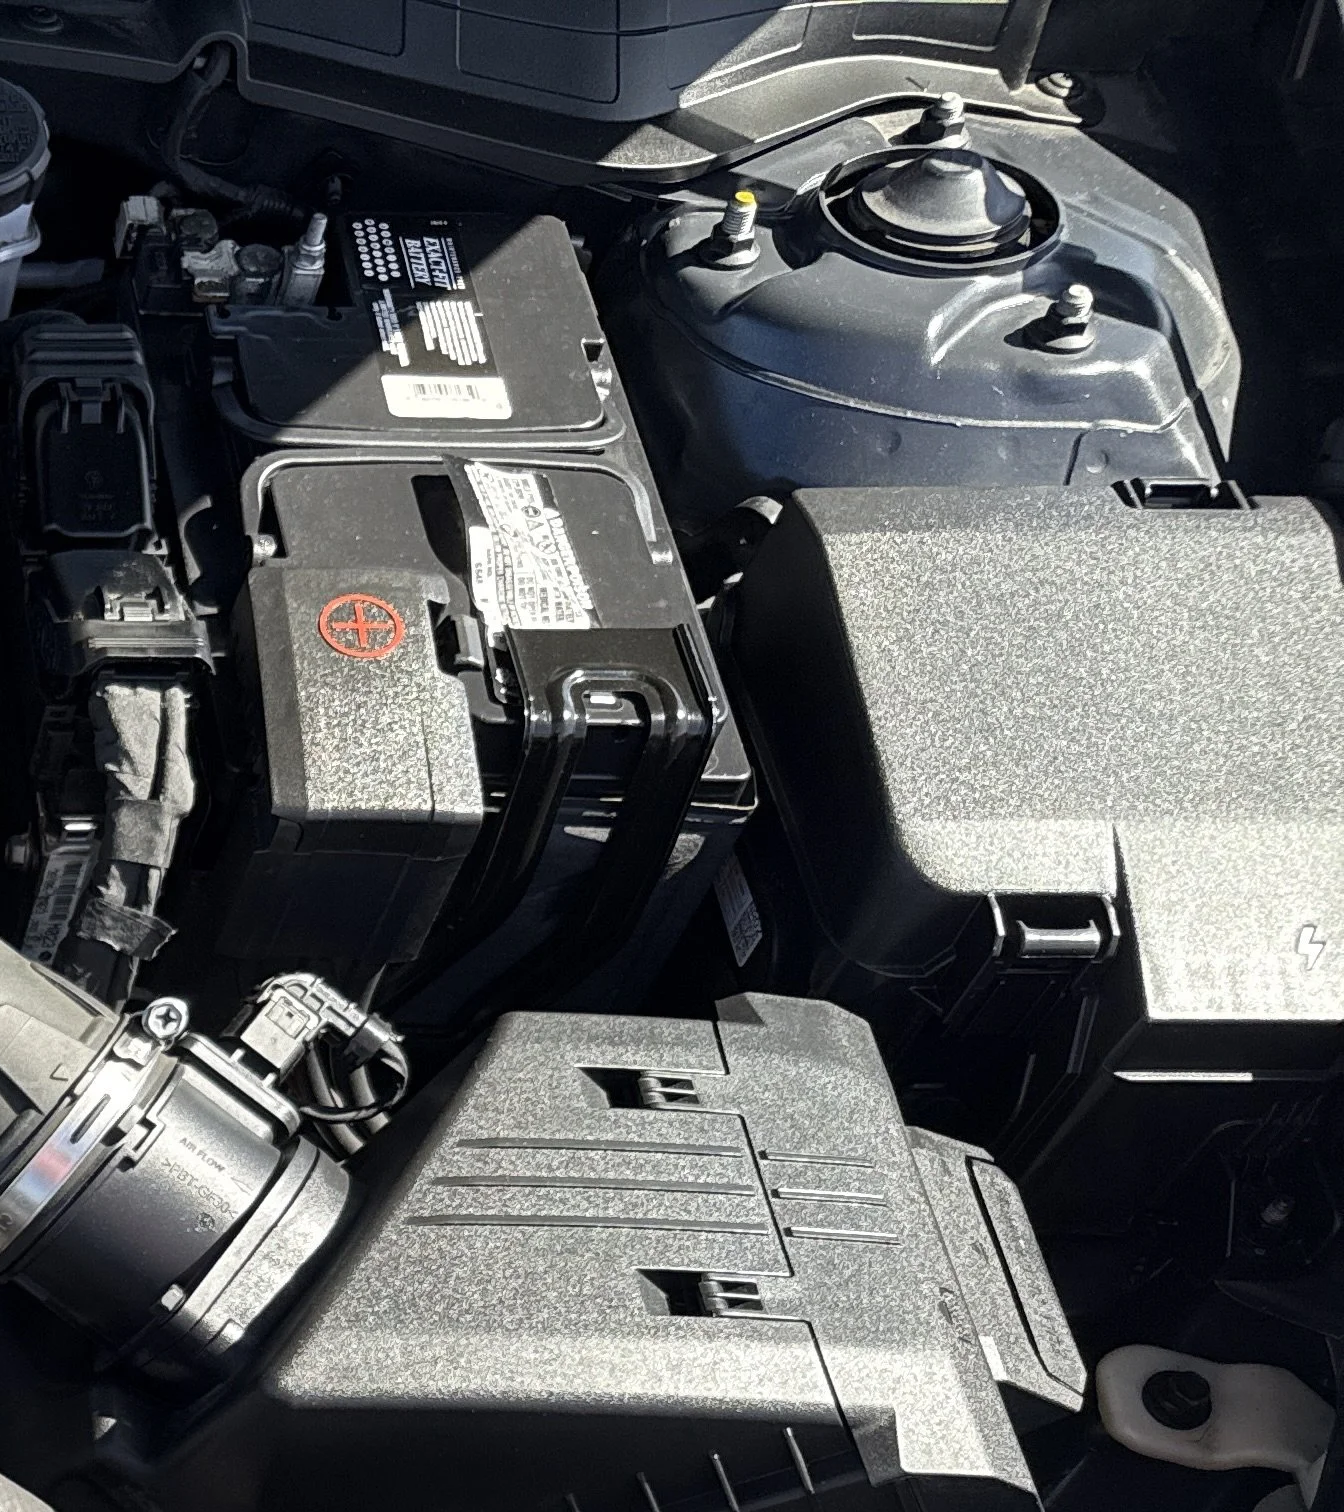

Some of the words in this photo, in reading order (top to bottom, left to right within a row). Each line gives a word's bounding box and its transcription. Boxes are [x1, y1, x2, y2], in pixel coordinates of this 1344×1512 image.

[404, 238, 433, 286] BATTERY
[422, 236, 453, 290] EXACT-FIT
[179, 1137, 197, 1153] AIR
[197, 1149, 226, 1172] FLOW
